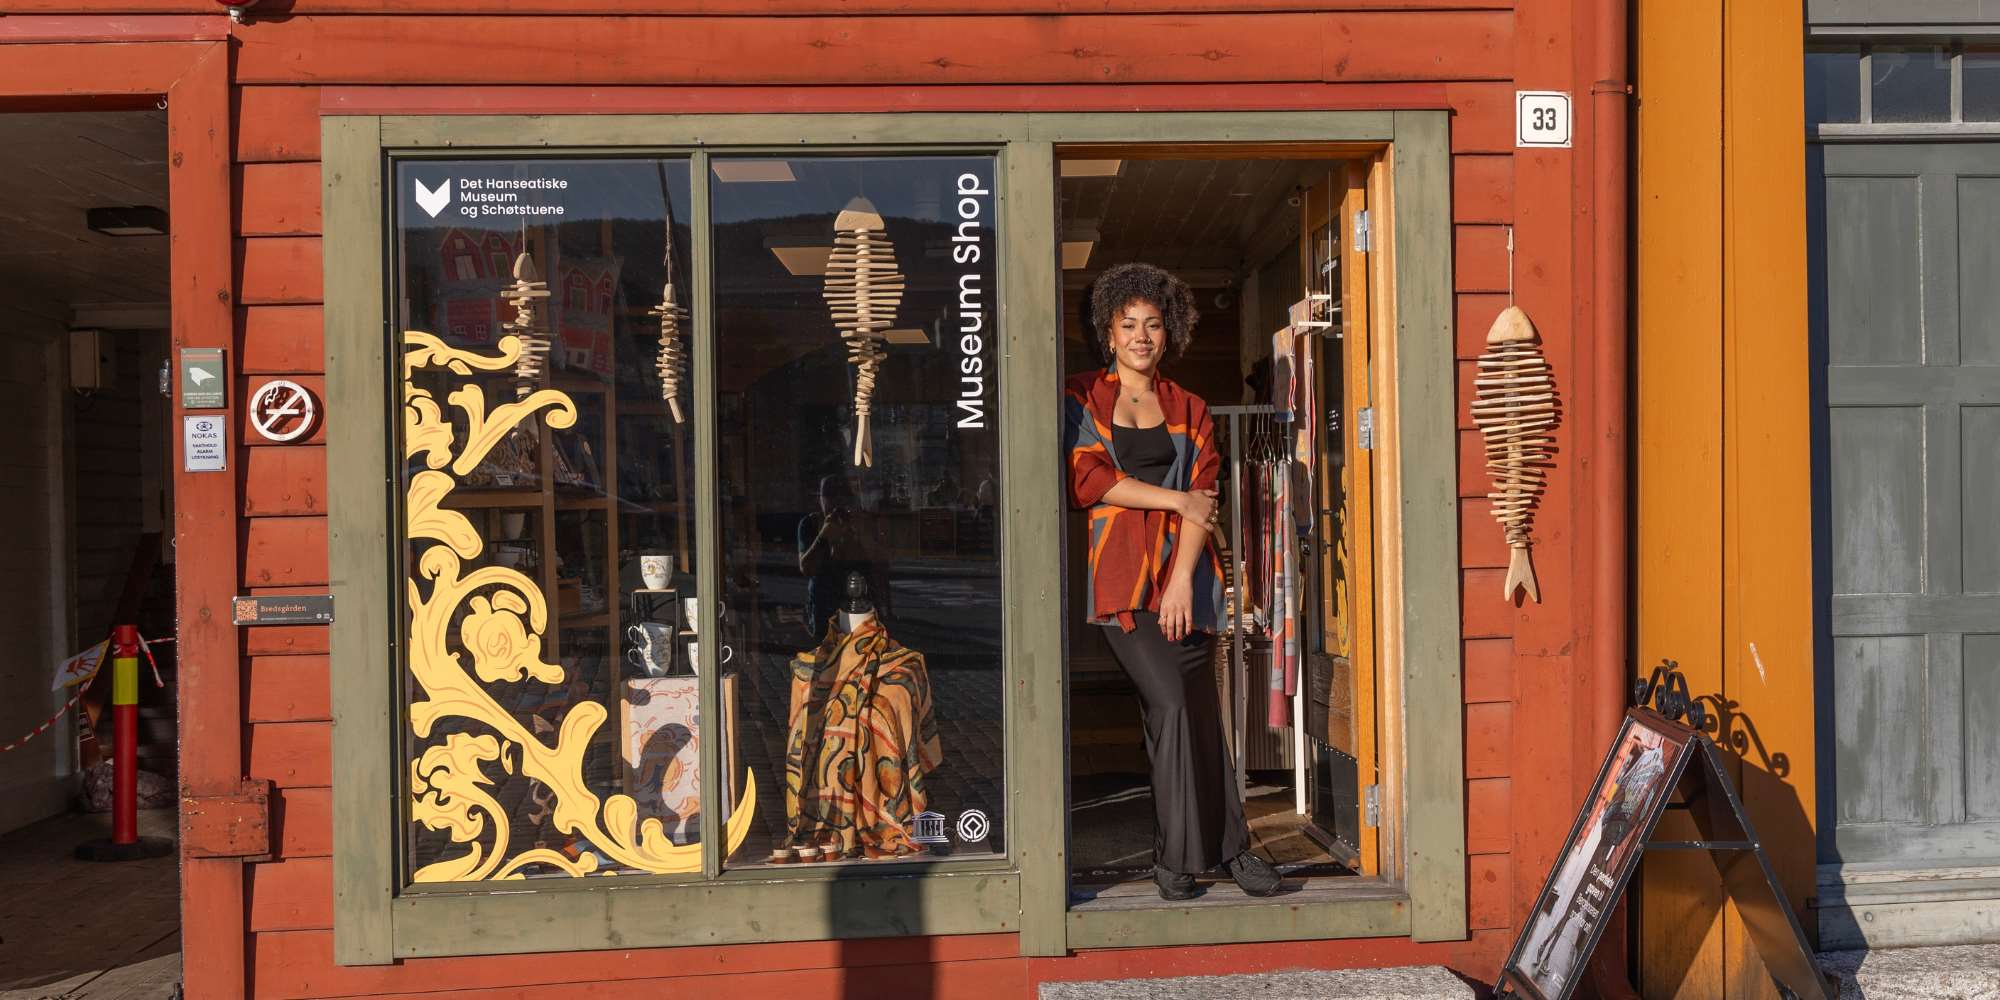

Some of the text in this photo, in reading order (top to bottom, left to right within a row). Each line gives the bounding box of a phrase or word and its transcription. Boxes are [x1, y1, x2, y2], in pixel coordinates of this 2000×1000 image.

[1533, 108, 1556, 130] 33
[460, 178, 568, 189] Det Hanseatiske
[460, 192, 517, 202] Museum
[460, 204, 564, 218] og Schøtstuene
[951, 173, 989, 429] Museum Shop
